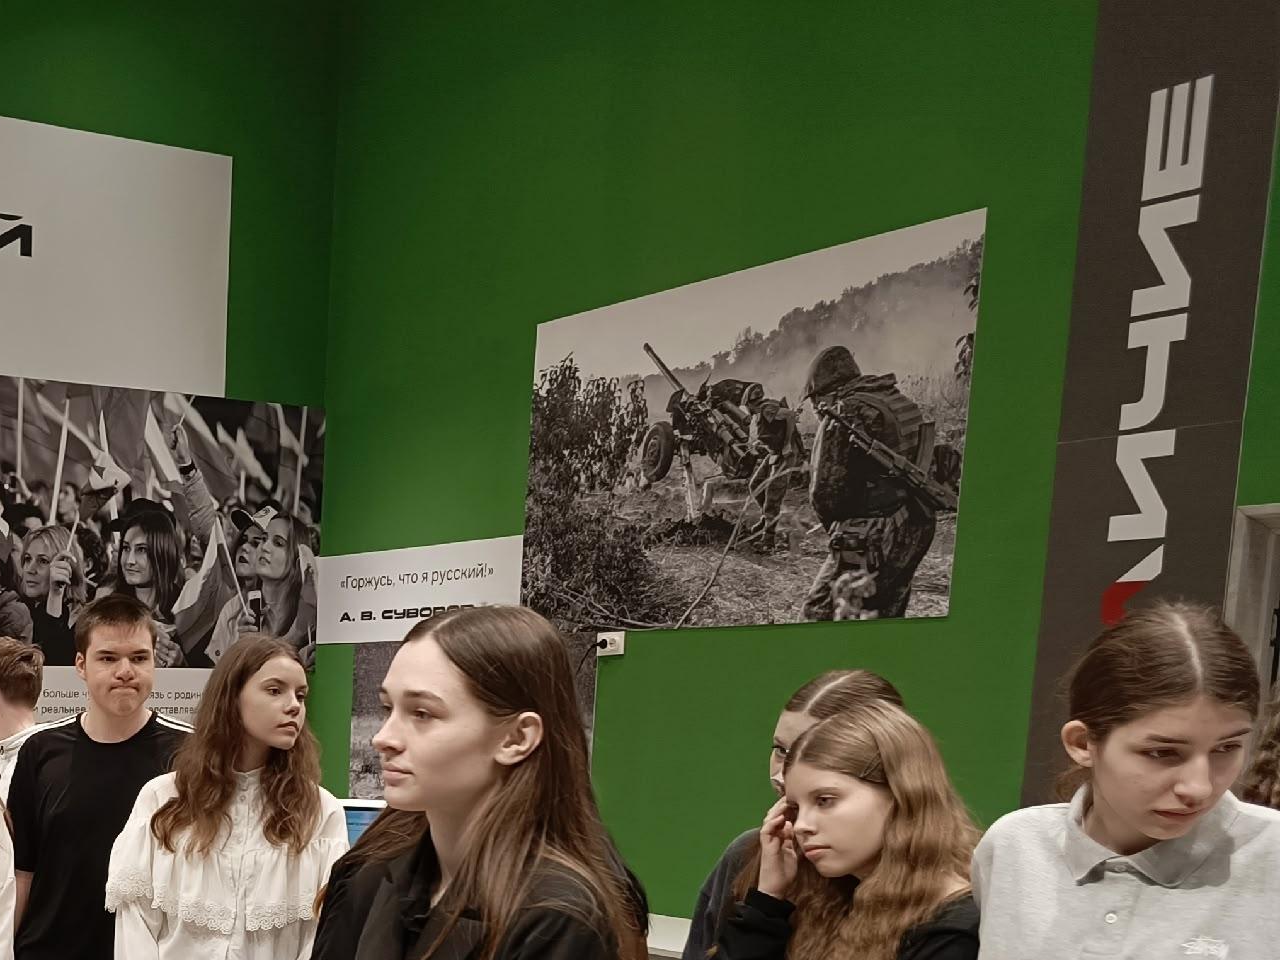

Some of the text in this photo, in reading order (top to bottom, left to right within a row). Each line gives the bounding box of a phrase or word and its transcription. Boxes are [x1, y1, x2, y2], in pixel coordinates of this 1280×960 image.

[1102, 74, 1215, 629] ЛИЧИЕ
[340, 563, 494, 592] «Горжусь, что я русский!»
[340, 612, 355, 622] А.
[360, 610, 376, 621] В.
[43, 688, 79, 698] больше
[150, 691, 165, 699] язь
[174, 691, 202, 700] родин
[41, 706, 87, 716] реальнее
